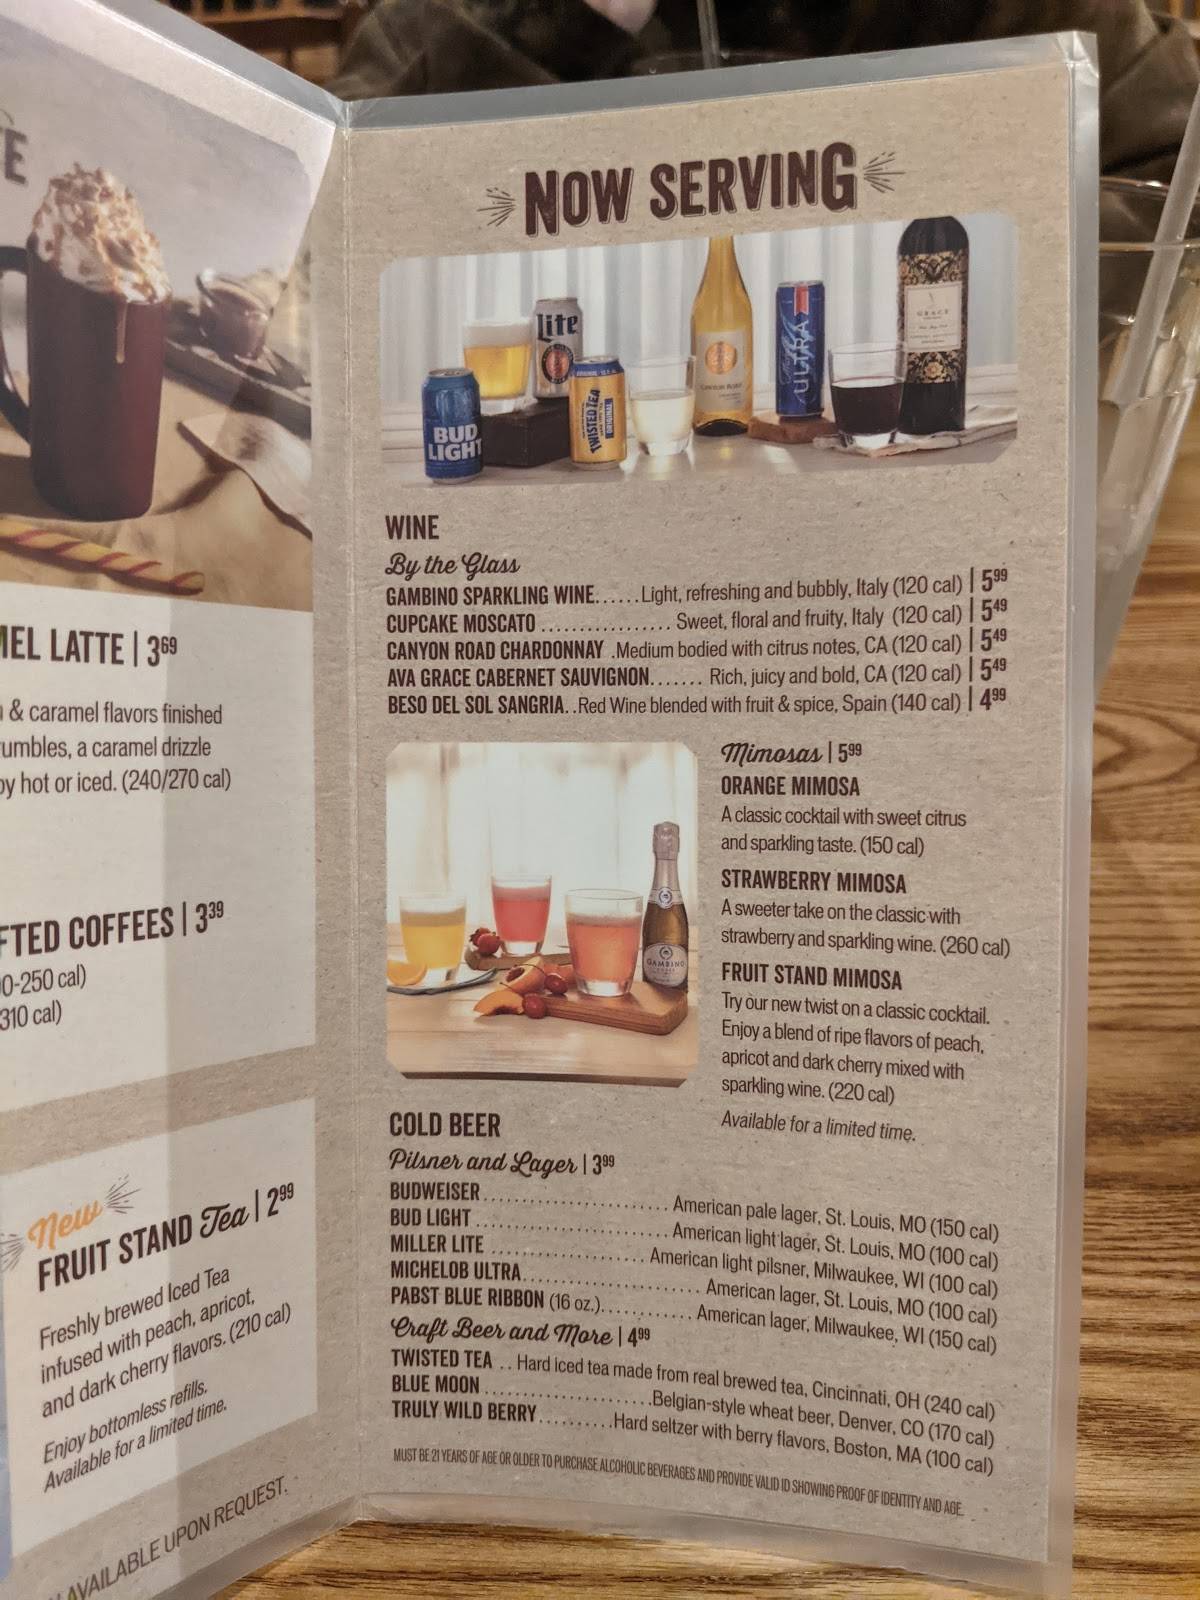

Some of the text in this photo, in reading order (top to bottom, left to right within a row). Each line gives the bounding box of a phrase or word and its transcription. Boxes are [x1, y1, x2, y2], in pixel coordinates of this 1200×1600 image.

[525, 141, 857, 238] NOW SERVING
[537, 313, 578, 343] Lite
[793, 319, 810, 394] ULTRA
[428, 438, 482, 461] LIGHT
[433, 423, 478, 444] BUD
[385, 515, 439, 540] WINE
[385, 552, 521, 581] By the Glass
[386, 587, 458, 606] GAMBINO
[463, 585, 548, 605] SPARKLING
[554, 585, 595, 604] WINE
[642, 585, 682, 606] Light,
[687, 583, 760, 602] refreshing
[764, 580, 792, 599] and
[797, 579, 851, 600] bubbly,
[857, 577, 889, 599] Italy
[893, 575, 928, 598] (120
[933, 574, 962, 596] cal)
[50, 628, 124, 665] LATTE
[9, 698, 222, 724] & caramel flavors finished
[388, 695, 427, 714] BESO
[432, 696, 460, 714] DEL
[465, 695, 494, 714] SOL
[498, 695, 564, 714] SANGRIA
[579, 697, 606, 714] Red
[609, 696, 647, 714] Wine
[650, 696, 707, 713] blended
[711, 696, 741, 713] with
[746, 696, 774, 712] fruit
[778, 695, 790, 712] &
[794, 696, 838, 715] spice,
[842, 694, 887, 715] Spain
[891, 693, 926, 714] (140
[931, 693, 961, 714] cal)
[721, 742, 862, 767] Mimosas 599
[21, 768, 231, 795] hot or iced. (240/270 cal)
[721, 776, 860, 796] ORANGE MIMOSA
[721, 805, 967, 827] A classic cocktail with sweet citrus
[721, 869, 907, 894] STRAWBERRY MIMOSA
[69, 906, 174, 950] COFFEES
[722, 962, 902, 990] FRUIT STAND MIMOSA
[390, 1112, 500, 1138] COLD BEER
[721, 1110, 915, 1143] Available for a limited time.
[389, 1148, 463, 1170] Pilsner
[467, 1153, 508, 1171] and
[510, 1150, 578, 1180] Lager
[28, 1199, 104, 1250] New
[390, 1181, 999, 1244] BUDWEISER American pale lager, St. Louis, MO (150 cal)
[38, 1239, 111, 1293] FRUIT
[119, 1214, 192, 1264] STAND
[200, 1203, 250, 1238] Tea
[40, 1268, 230, 1351] Freshly brewed Iced Tea
[390, 1316, 449, 1344] Craft
[452, 1317, 506, 1339] Beer
[509, 1323, 550, 1341] and
[554, 1324, 613, 1347] More
[42, 1302, 291, 1418] and dark cherry flavors. (210 cal)
[392, 1374, 994, 1450] BLUE MOON Belgian-style wheat beer, Denver, CO (170 cal)
[44, 1399, 227, 1493] Available for a limited time.
[394, 1448, 964, 1516] MUST BE 21 YEARS OF AGE OR OLDER TO PURCHASE ALCOHOLIC BEVERAGES AND PROVIDE VALID ID SHOWING PROOF OF IDENTITY AND AGE.
[165, 1513, 210, 1552] UPON
[214, 1476, 287, 1527] REQUEST.
